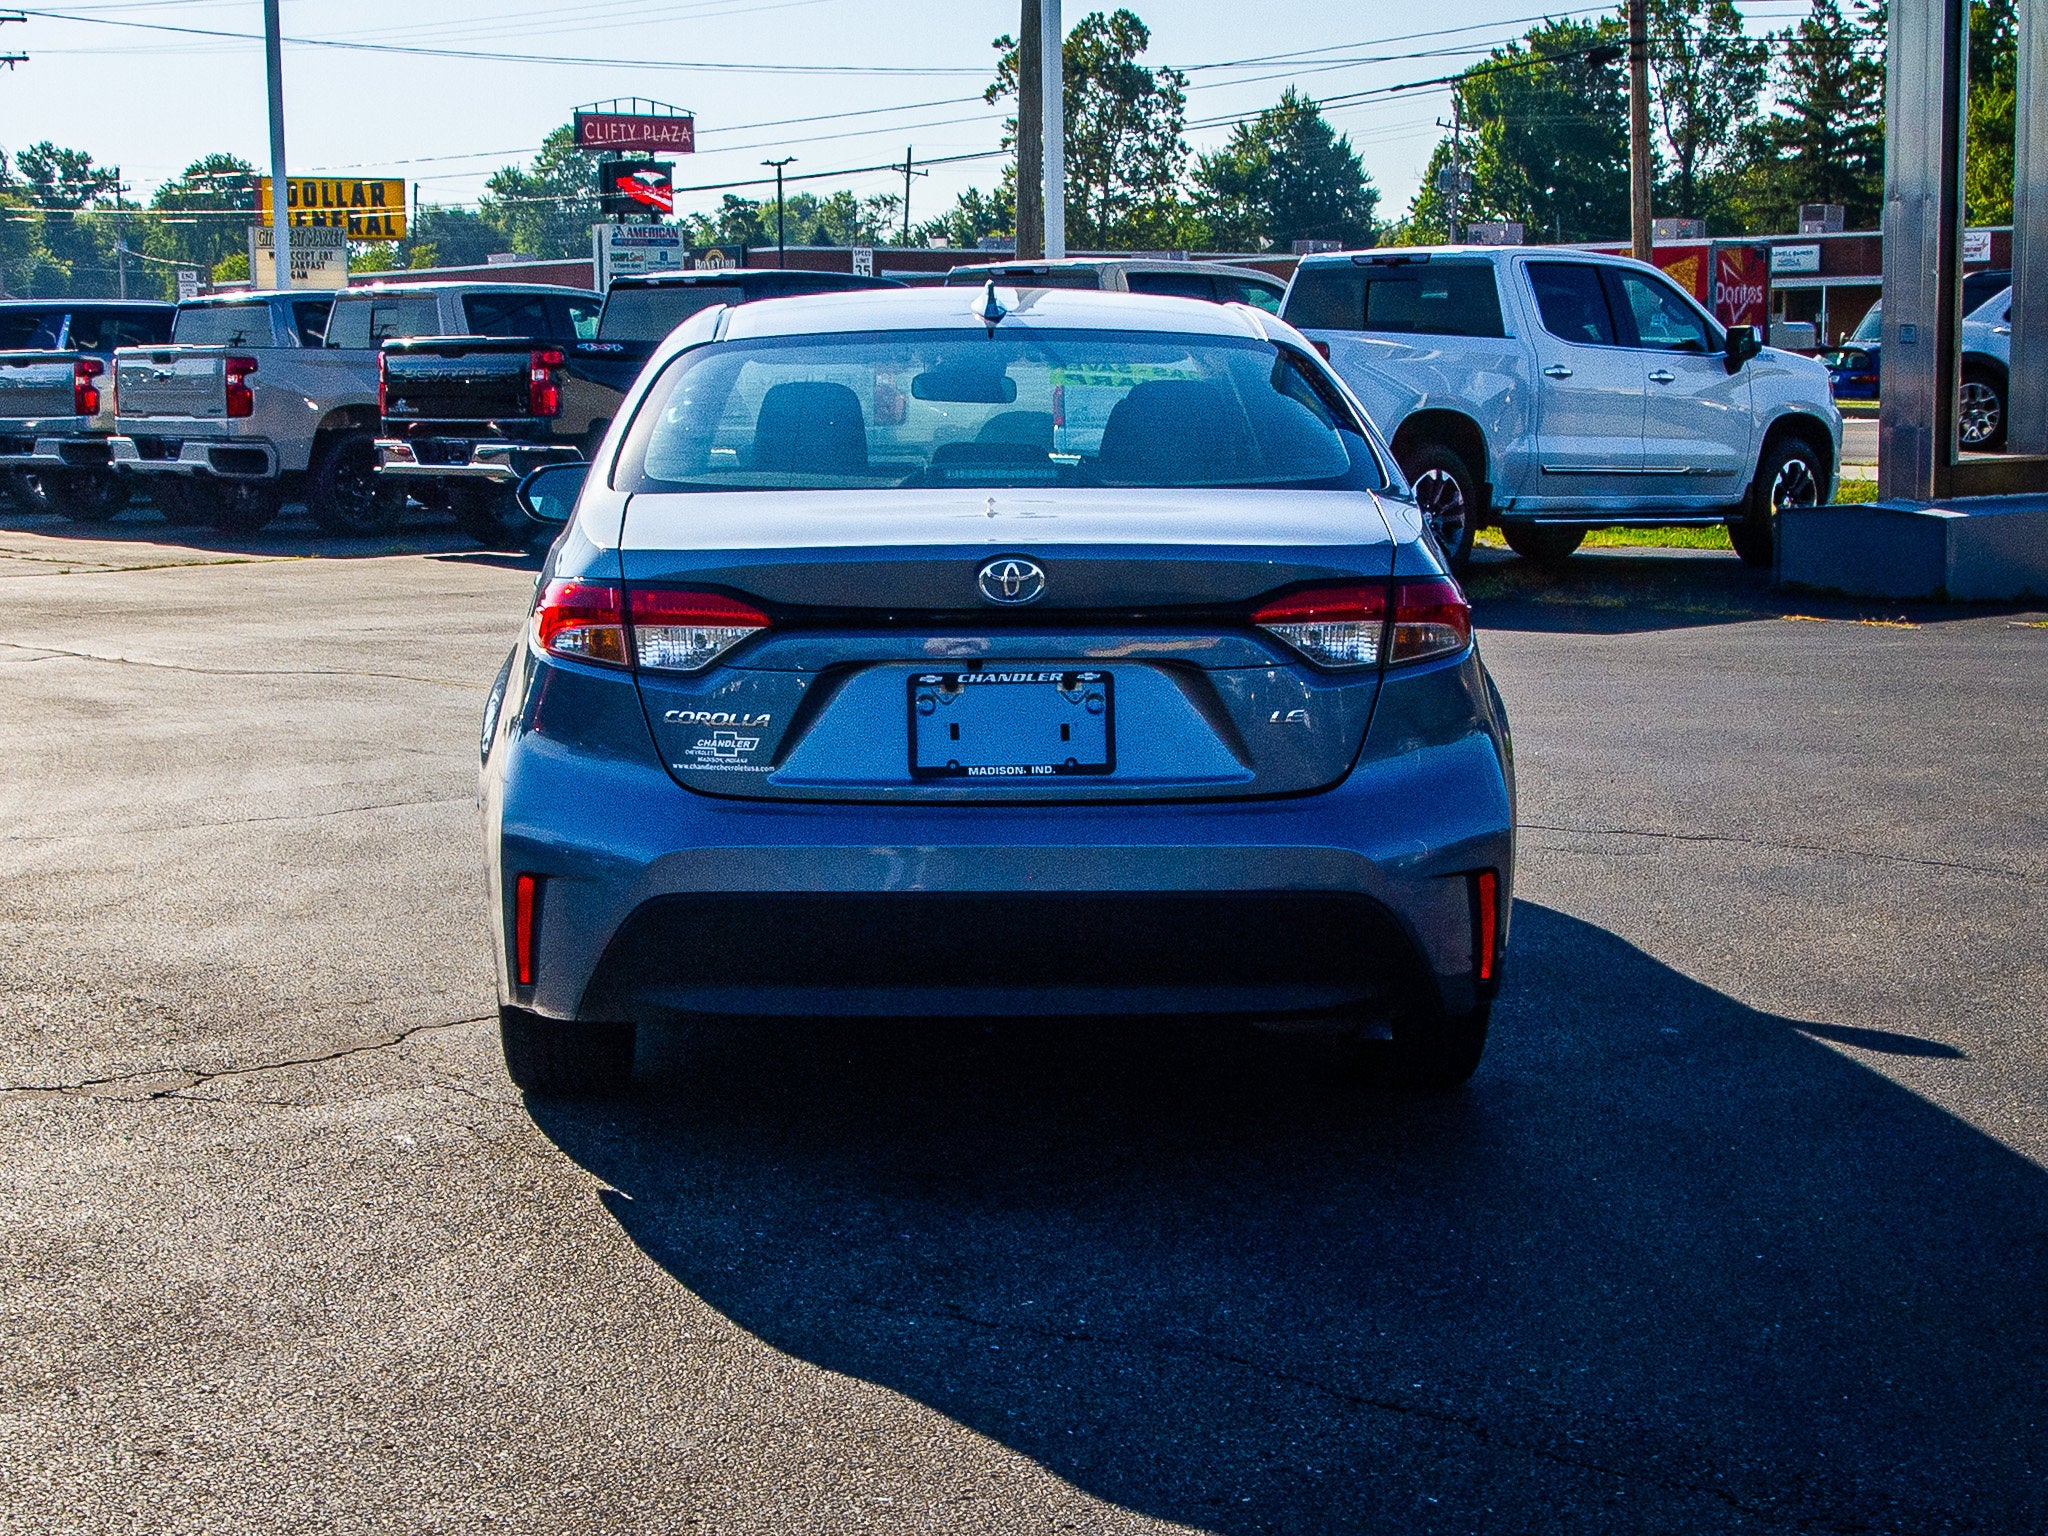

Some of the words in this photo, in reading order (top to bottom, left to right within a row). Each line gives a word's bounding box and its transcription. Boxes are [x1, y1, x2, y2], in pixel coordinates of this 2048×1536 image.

[584, 121, 636, 141] CLIFTY
[643, 125, 691, 143] PLAZA
[287, 181, 386, 208] DOLLAR
[288, 210, 397, 236] ENERAL
[258, 229, 275, 247] CIT
[306, 229, 345, 248] MARKET
[627, 226, 679, 238] AMERICAN
[290, 251, 316, 260] CCEPT
[290, 261, 326, 270] EAKFAST
[855, 264, 871, 277] 35
[1715, 281, 1763, 304] Doritos
[957, 672, 1064, 683] CHANDLER
[664, 709, 771, 727] COROLLA
[1270, 709, 1305, 723] LE
[697, 739, 751, 749] CHANDLER
[672, 763, 776, 772] www.chandlerchevroletusa.com
[1031, 765, 1056, 775] IND.
